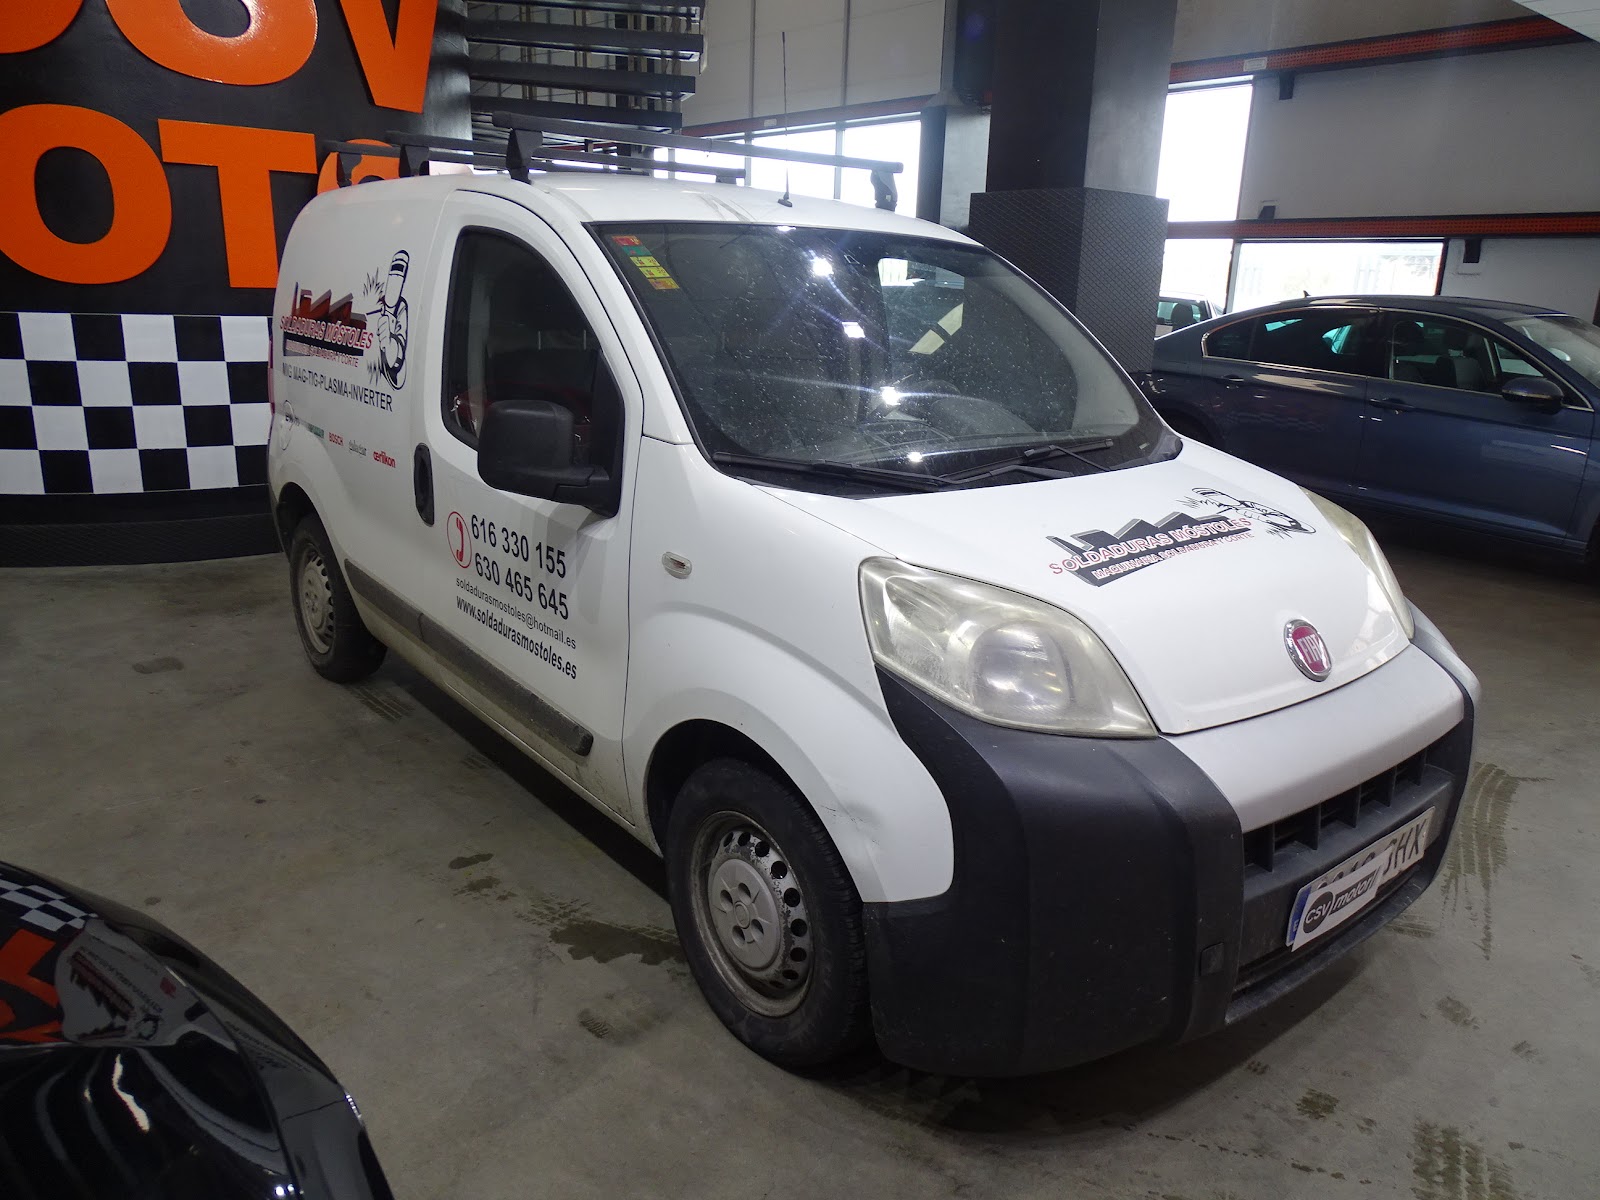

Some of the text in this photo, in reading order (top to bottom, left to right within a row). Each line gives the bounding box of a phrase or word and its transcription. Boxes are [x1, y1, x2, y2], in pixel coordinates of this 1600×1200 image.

[324, 320, 374, 349] MÓSTOLES
[471, 514, 566, 578] 616 330 155
[1049, 517, 1252, 574] SOLDADURAS MÓSTOLES
[456, 578, 576, 649] soldadurasmostoles@hotmail.es
[475, 552, 569, 620] 630 465 645
[456, 595, 577, 680] www.soldadurasmostoles.es
